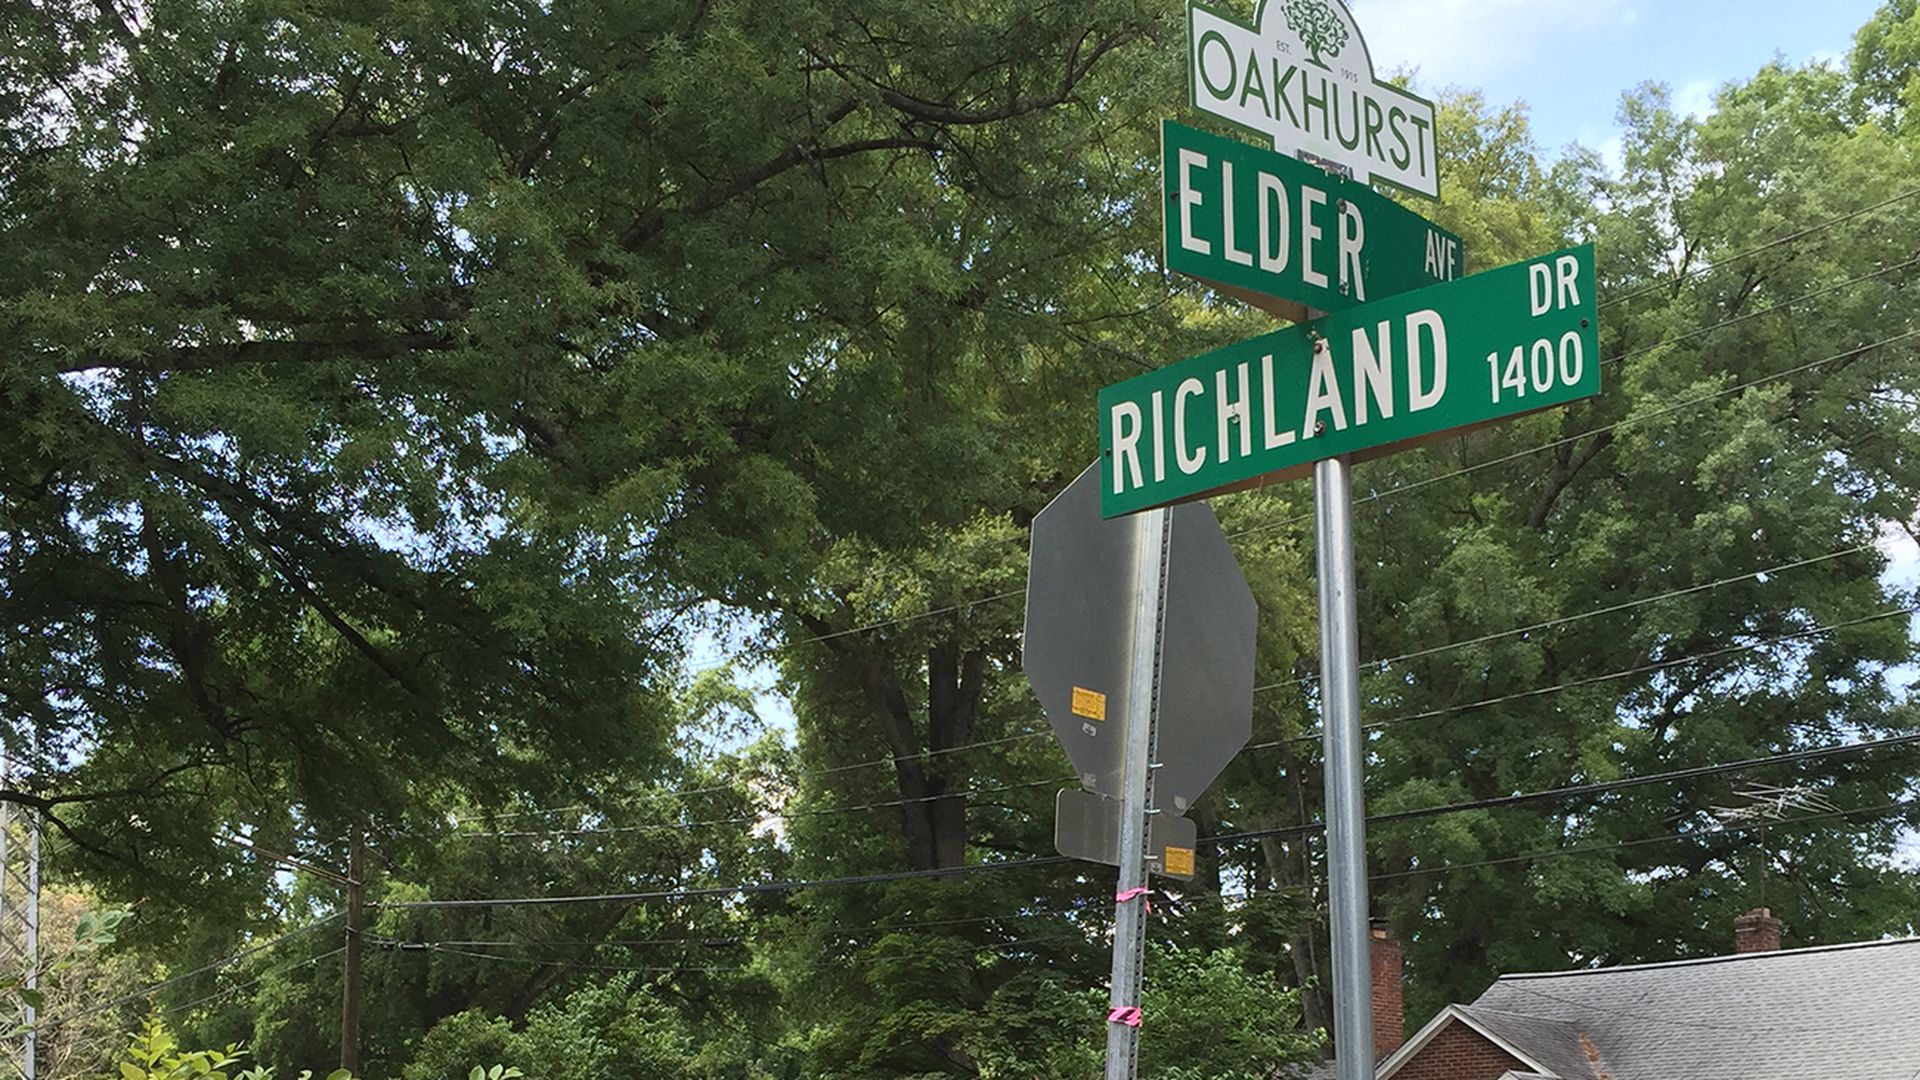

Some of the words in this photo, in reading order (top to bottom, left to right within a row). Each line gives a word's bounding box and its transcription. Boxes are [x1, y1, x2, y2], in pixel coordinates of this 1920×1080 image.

[1198, 30, 1430, 178] OAKHURST
[1178, 148, 1366, 302] ELDER
[1111, 308, 1448, 494] RICHLAND
[1529, 254, 1581, 317] DR
[1486, 331, 1584, 404] 1400
